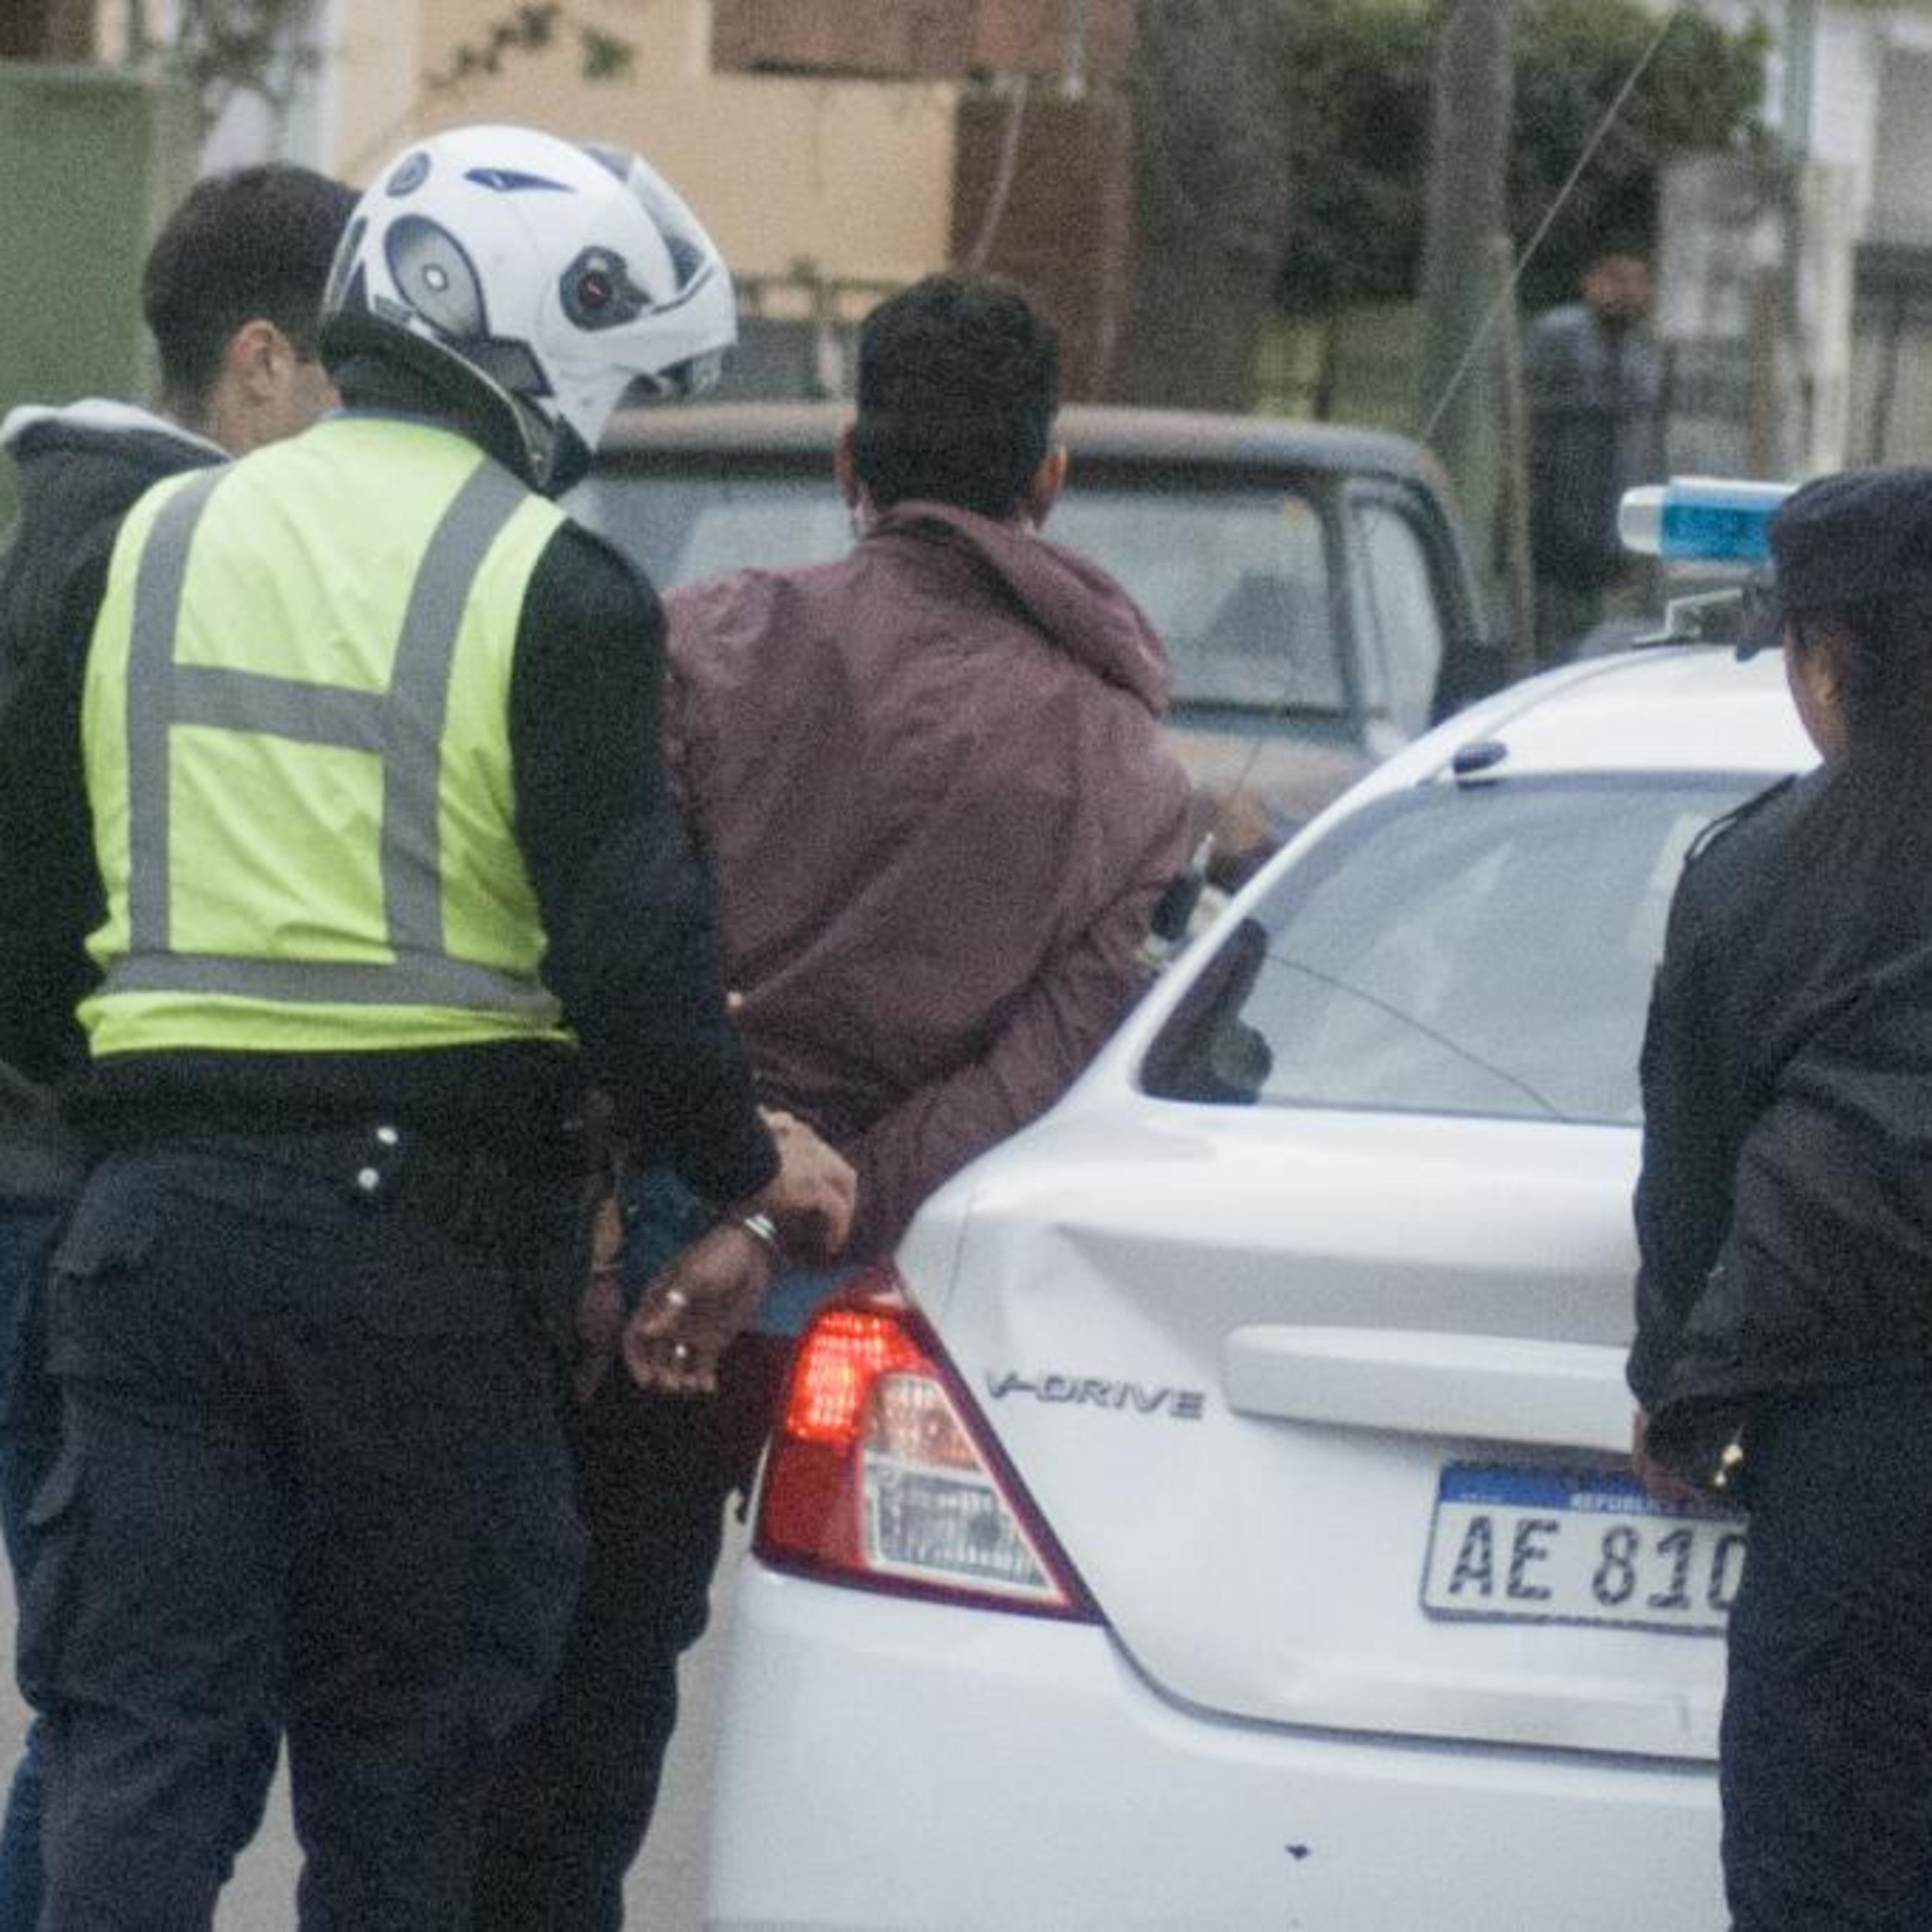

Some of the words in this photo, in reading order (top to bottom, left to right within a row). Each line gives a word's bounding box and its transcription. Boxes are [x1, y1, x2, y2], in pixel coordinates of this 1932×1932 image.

[986, 1372, 1206, 1419] V-DRIVE
[1448, 1515, 1559, 1599] AE
[1592, 1526, 1745, 1609] 810
